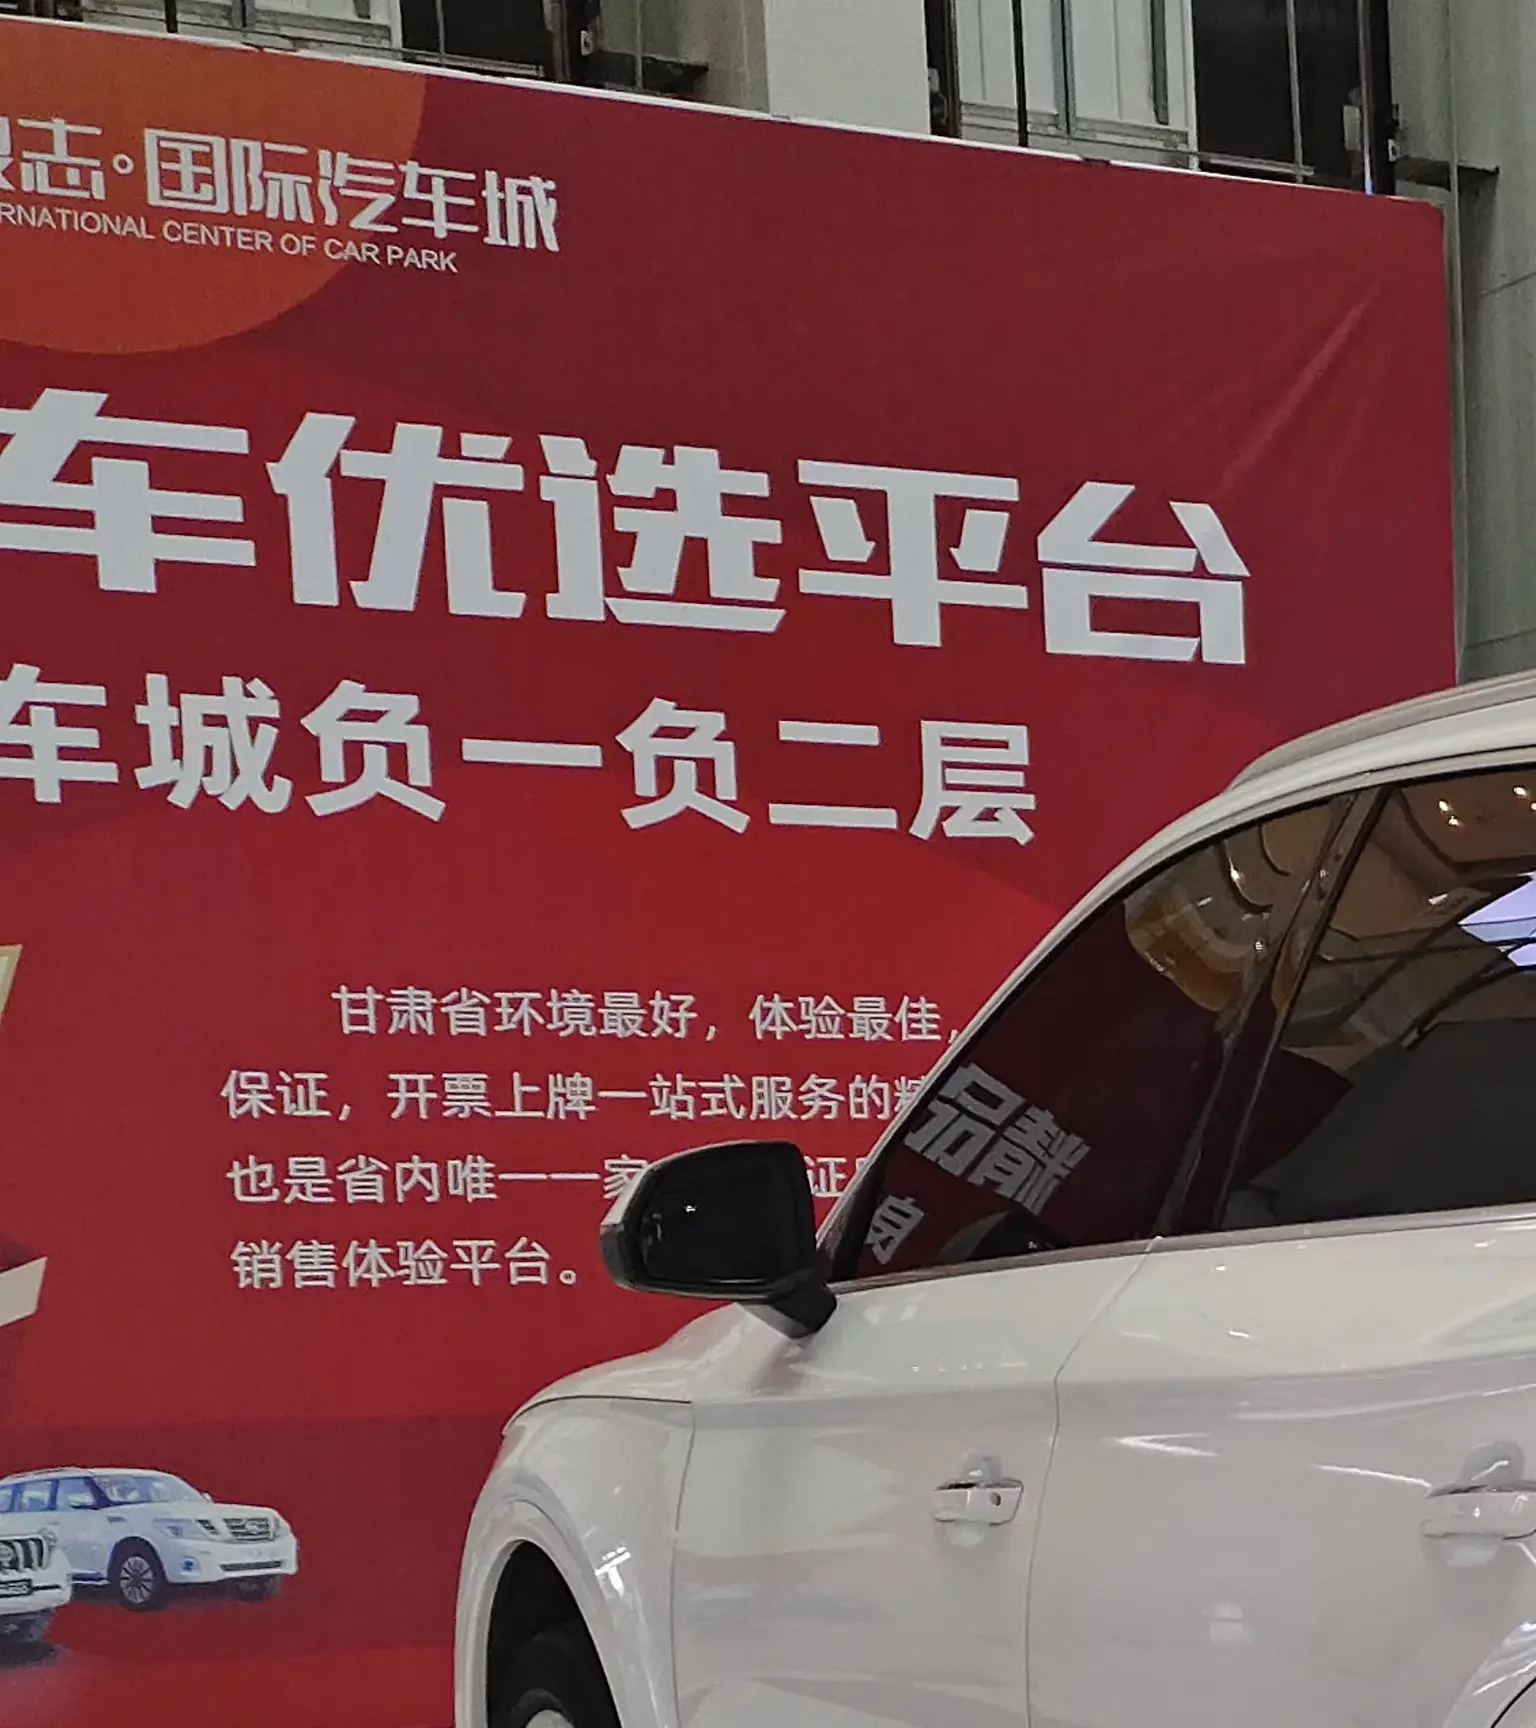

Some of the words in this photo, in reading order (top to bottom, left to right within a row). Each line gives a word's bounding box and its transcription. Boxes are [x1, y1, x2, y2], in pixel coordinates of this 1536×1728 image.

[162, 220, 273, 252] CENTER
[280, 233, 317, 256] OF
[324, 238, 380, 265] CAR
[387, 245, 459, 274] PARK
[0, 388, 1249, 666] 车优选平台
[0, 662, 1037, 847] 车城负一负二层
[230, 1237, 577, 1290] 销售体验平台。
